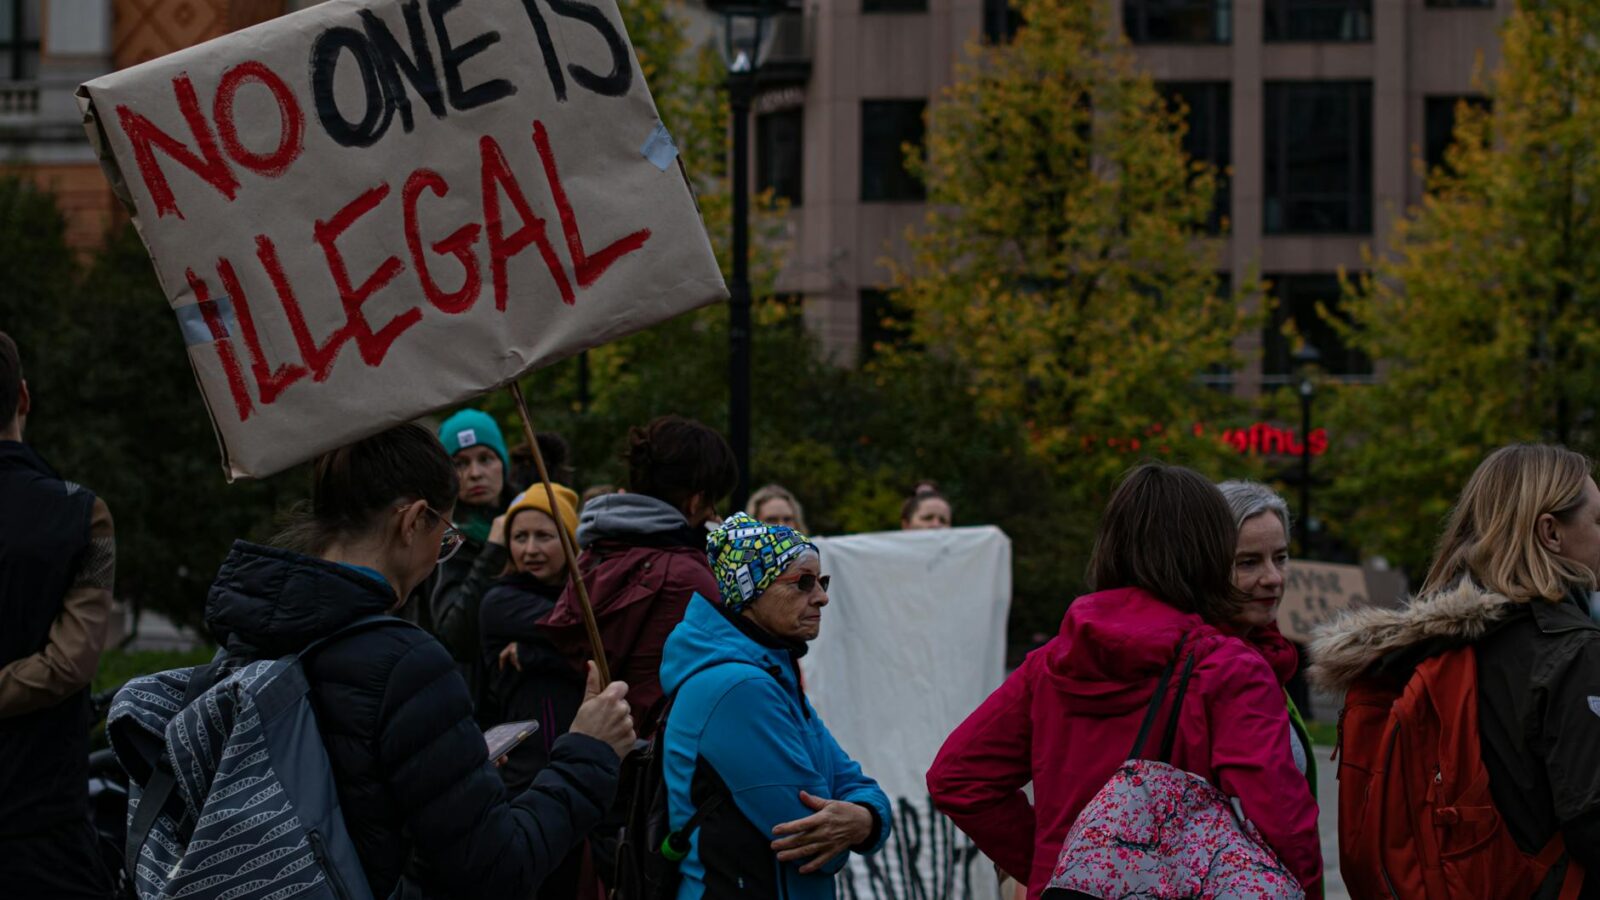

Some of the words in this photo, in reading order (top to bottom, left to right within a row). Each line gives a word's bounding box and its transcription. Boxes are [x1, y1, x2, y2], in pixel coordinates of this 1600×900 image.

[116, 59, 305, 221] NO
[308, 0, 518, 148] ONE
[521, 0, 633, 102] IS
[185, 120, 652, 422] ILLEGAL
